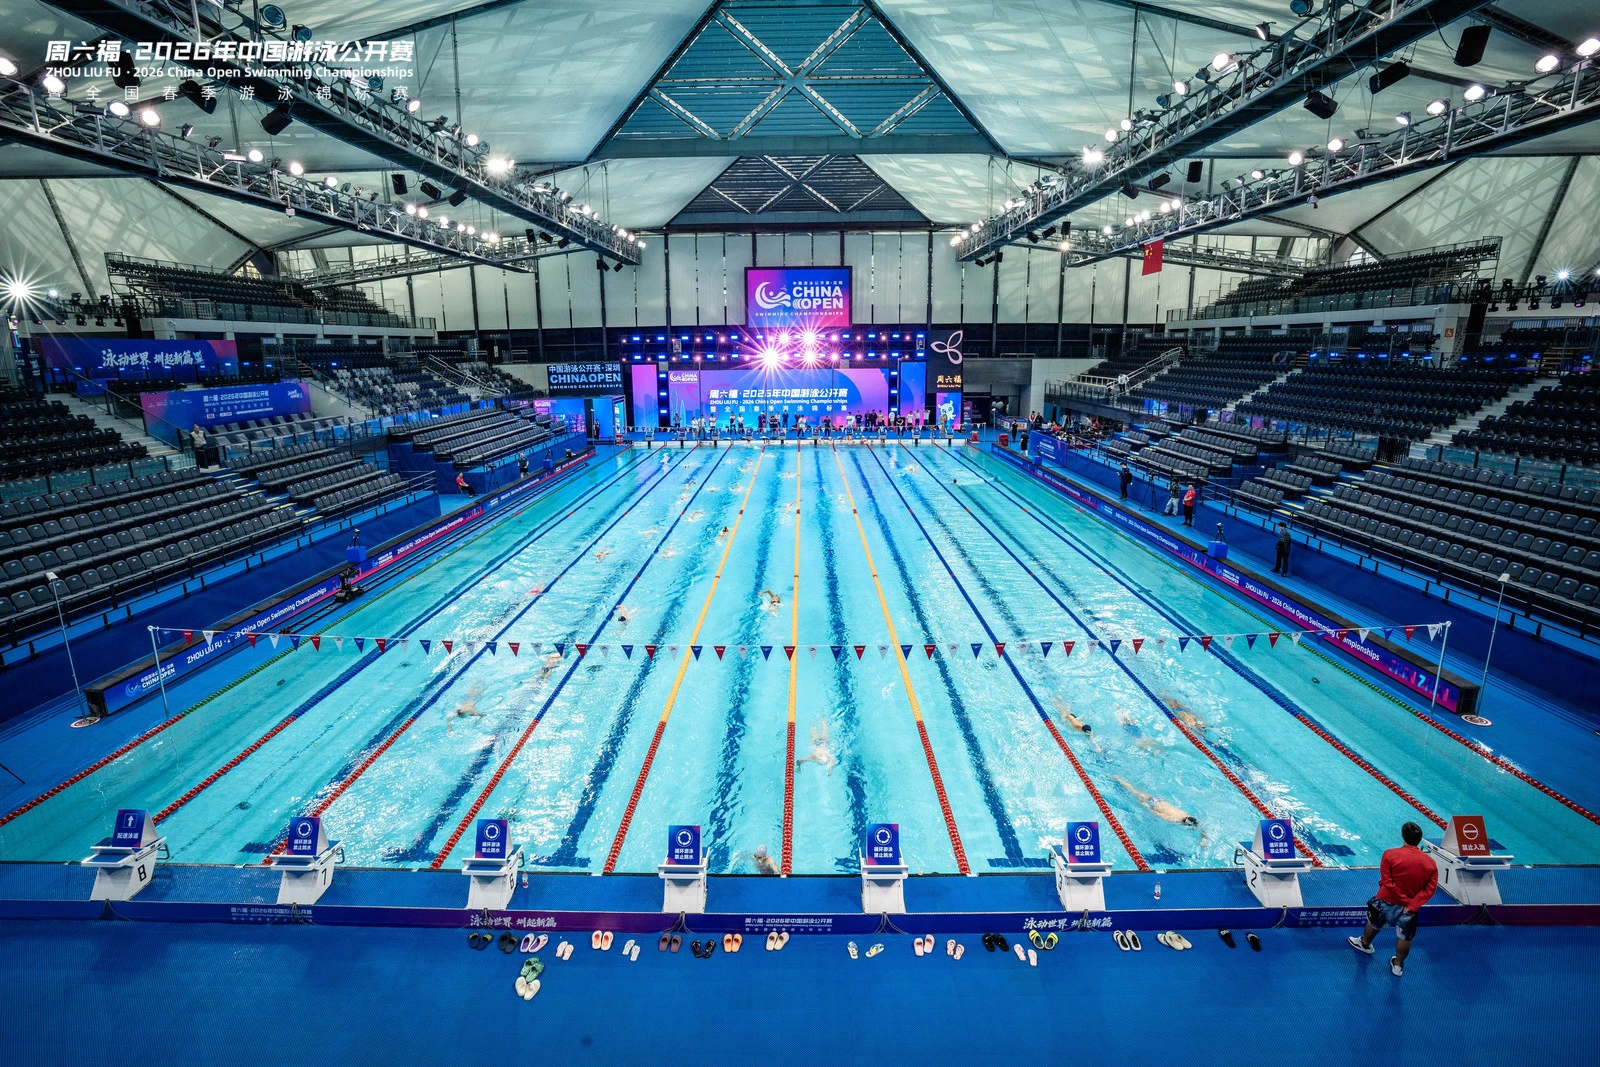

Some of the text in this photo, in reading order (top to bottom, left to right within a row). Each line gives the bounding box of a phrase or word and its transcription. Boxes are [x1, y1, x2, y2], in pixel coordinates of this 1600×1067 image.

[792, 286, 843, 297] CHINA
[800, 298, 843, 309] OPEN
[186, 649, 205, 664] ZHOU
[214, 640, 223, 650] FU
[256, 614, 271, 628] Open
[270, 603, 296, 620] Swimming
[295, 586, 327, 607] Championships
[1282, 602, 1295, 614] China
[1296, 610, 1309, 621] Open
[1336, 631, 1380, 661] Campionships
[137, 864, 147, 882] 8
[1250, 870, 1257, 888] 2
